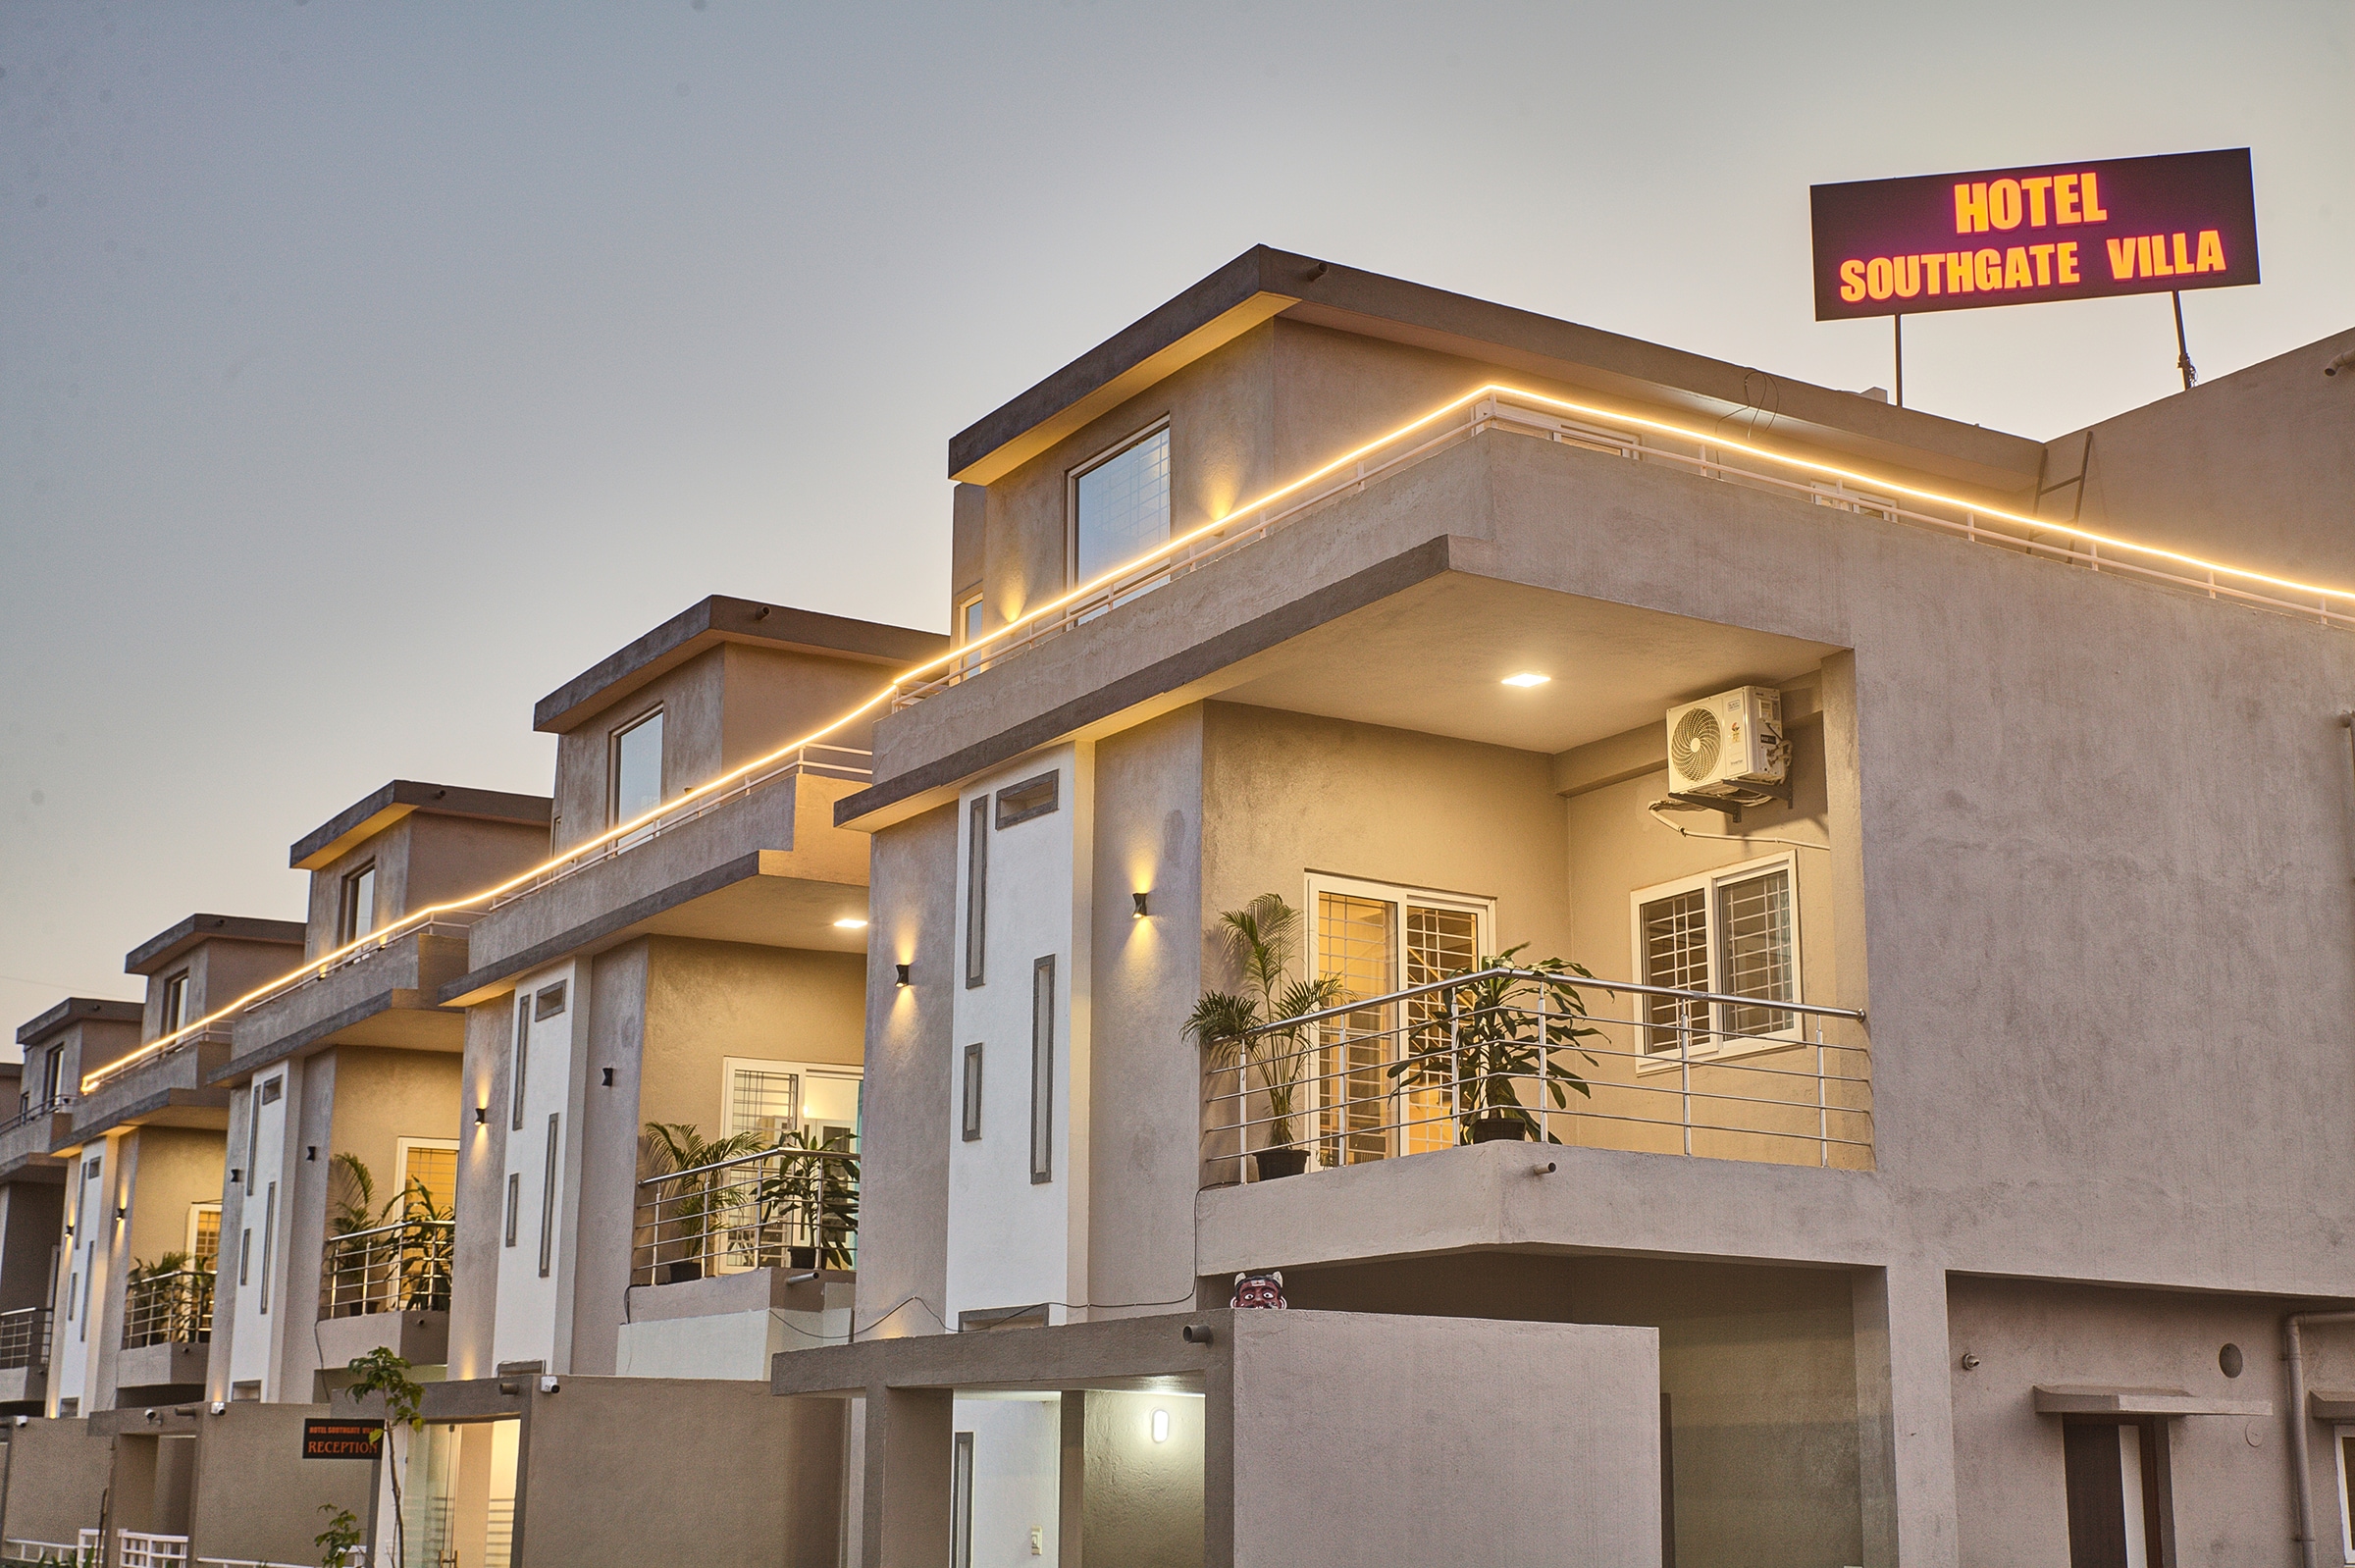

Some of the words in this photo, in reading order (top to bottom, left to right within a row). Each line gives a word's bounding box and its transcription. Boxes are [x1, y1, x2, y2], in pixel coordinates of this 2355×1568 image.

[1954, 172, 2108, 235] HOTEL
[1839, 240, 2080, 302] SOUTHGATE
[2106, 229, 2226, 280] VILLA
[308, 1440, 378, 1453] RECEPTION
